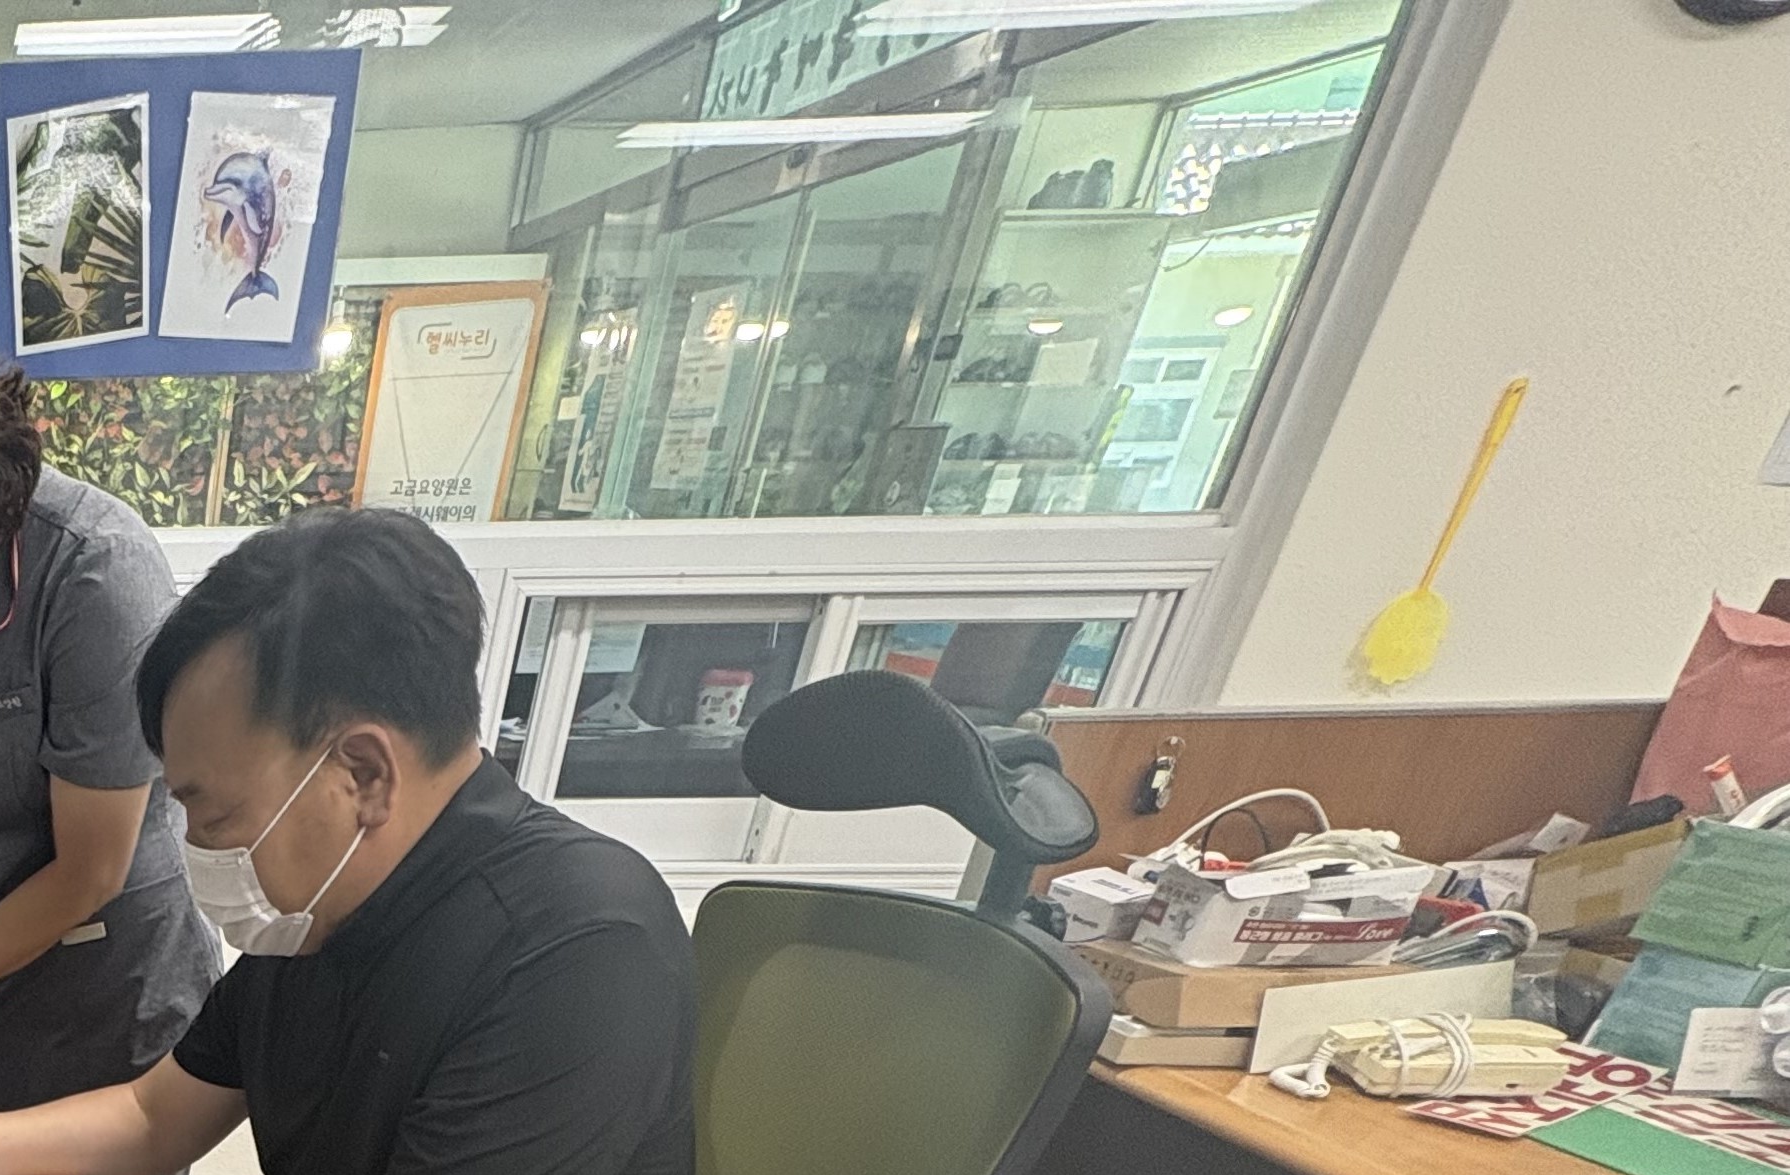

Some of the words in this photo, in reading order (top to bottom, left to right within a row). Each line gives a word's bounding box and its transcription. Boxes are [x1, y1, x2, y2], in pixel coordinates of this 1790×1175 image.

[426, 328, 490, 355] 헬씨누리
[390, 477, 472, 497] 고금요양원은
[397, 504, 477, 523] 레시웨이의
